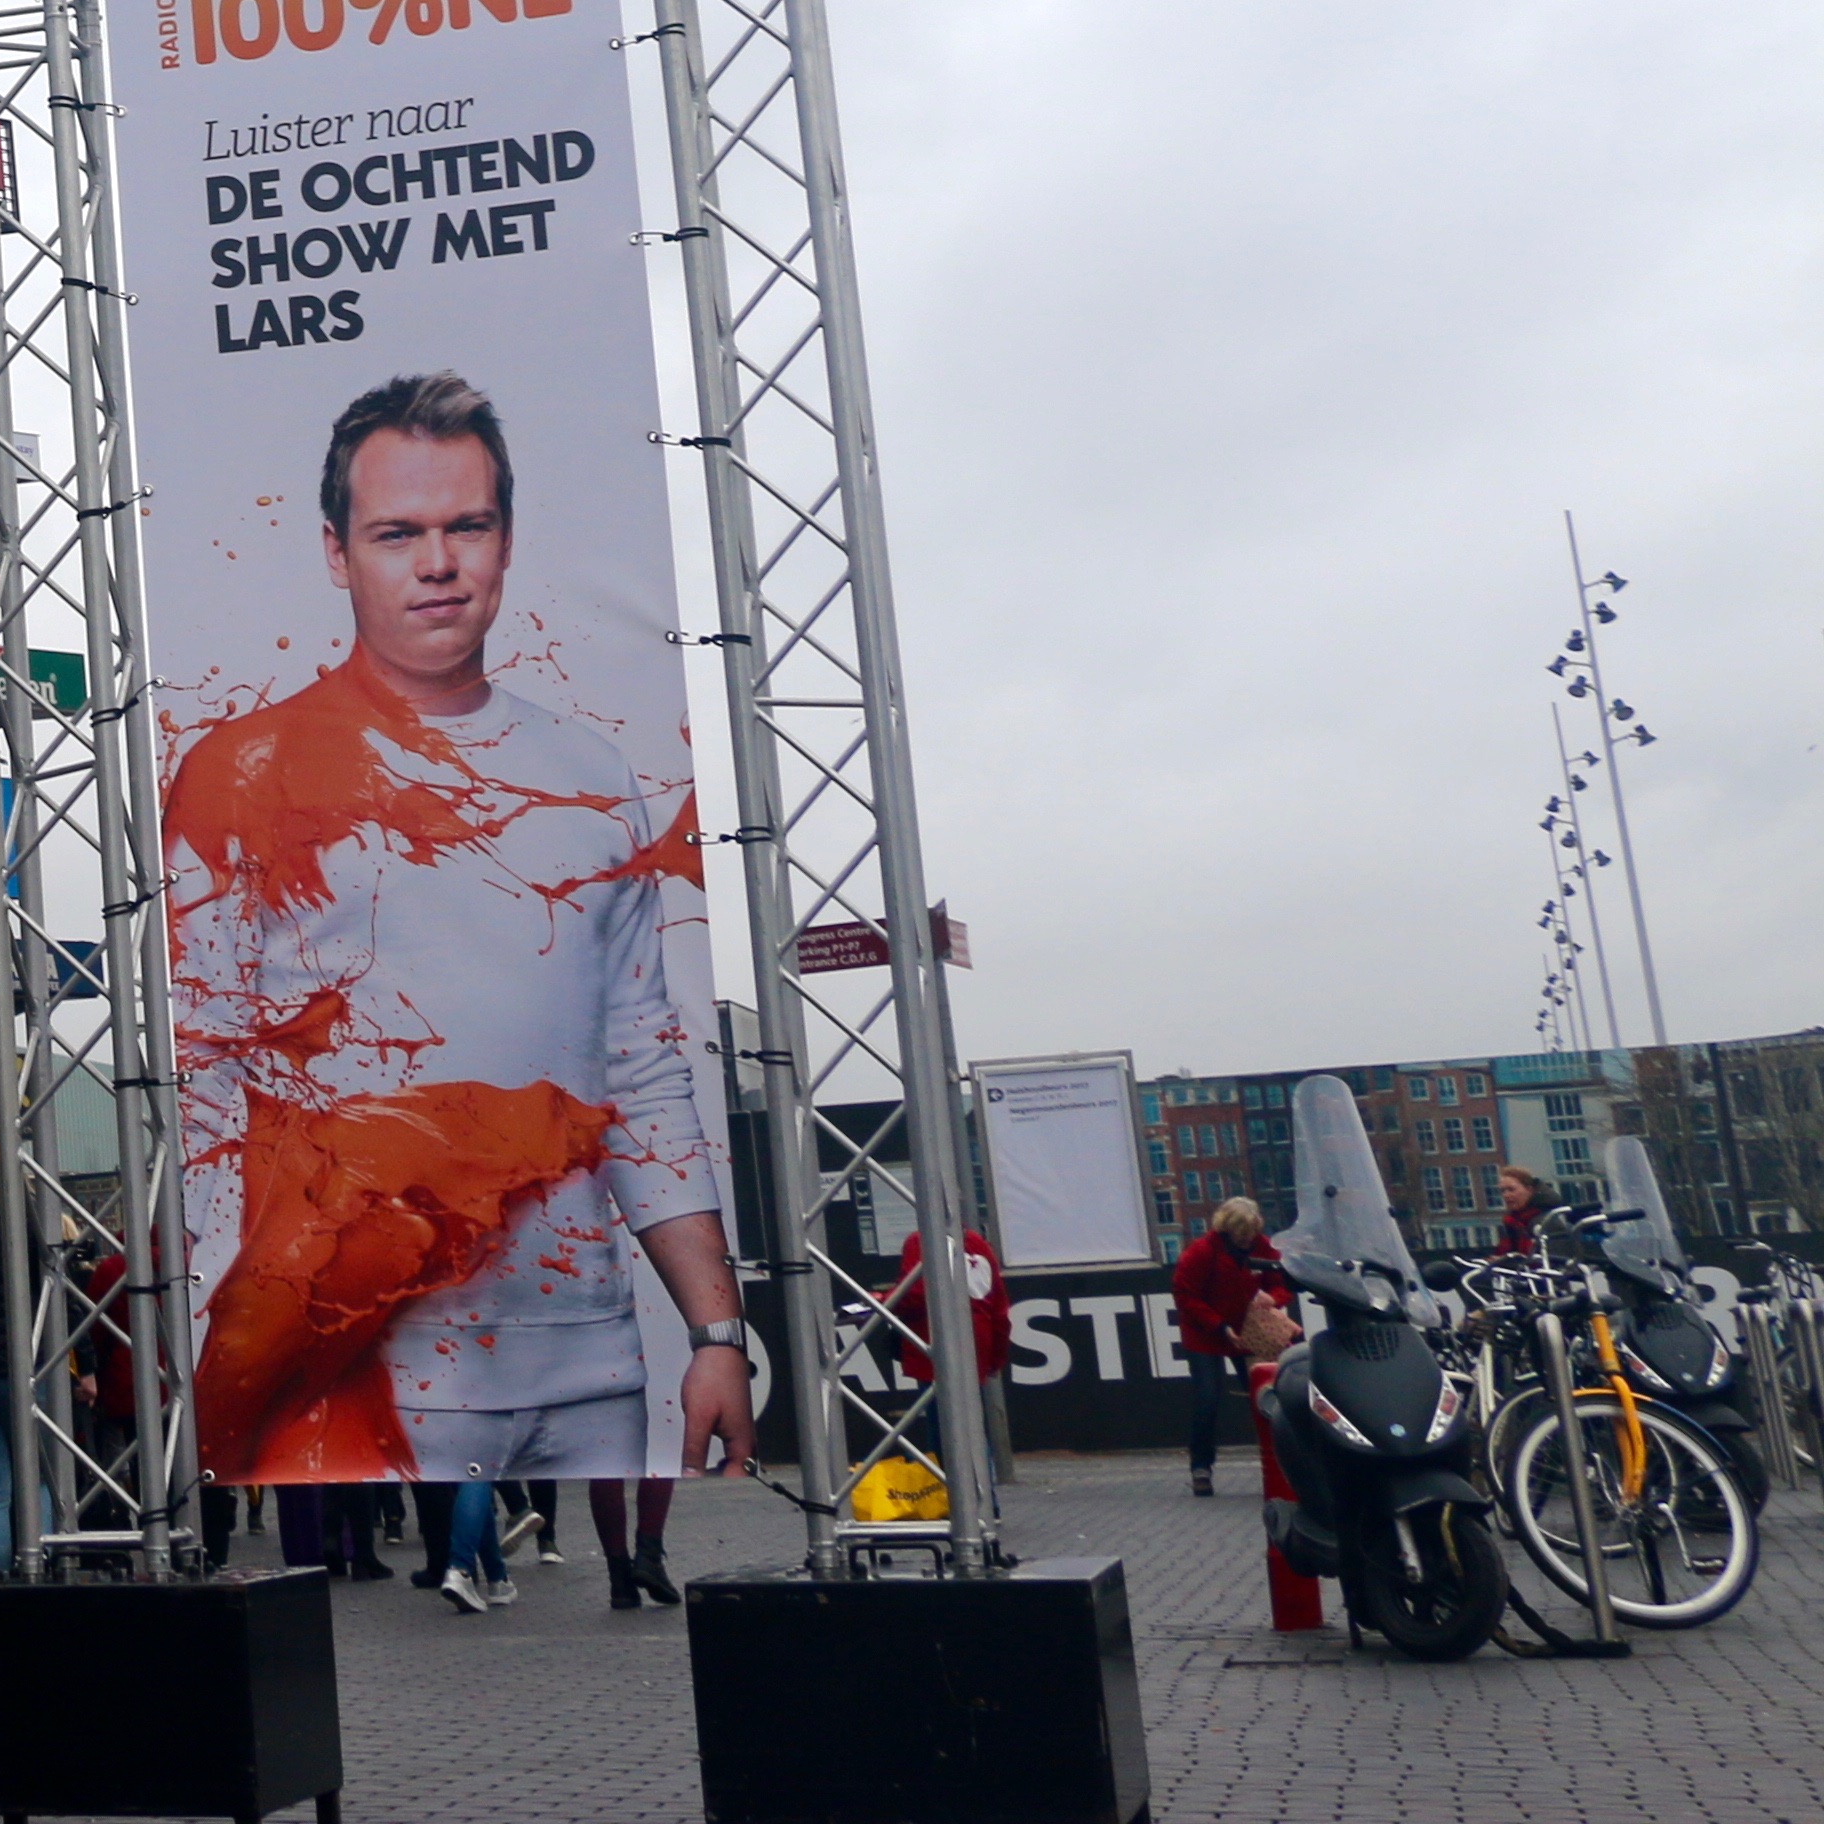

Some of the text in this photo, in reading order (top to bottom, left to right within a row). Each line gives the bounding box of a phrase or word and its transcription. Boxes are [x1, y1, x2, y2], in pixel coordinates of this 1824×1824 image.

[202, 97, 475, 161] Luister naar
[205, 129, 596, 225] DE OCHTEND
[210, 198, 556, 289] SHOW MET
[214, 289, 365, 354] LARS
[797, 930, 836, 944] ongress
[799, 944, 831, 957] arking
[799, 956, 838, 969] ntrance
